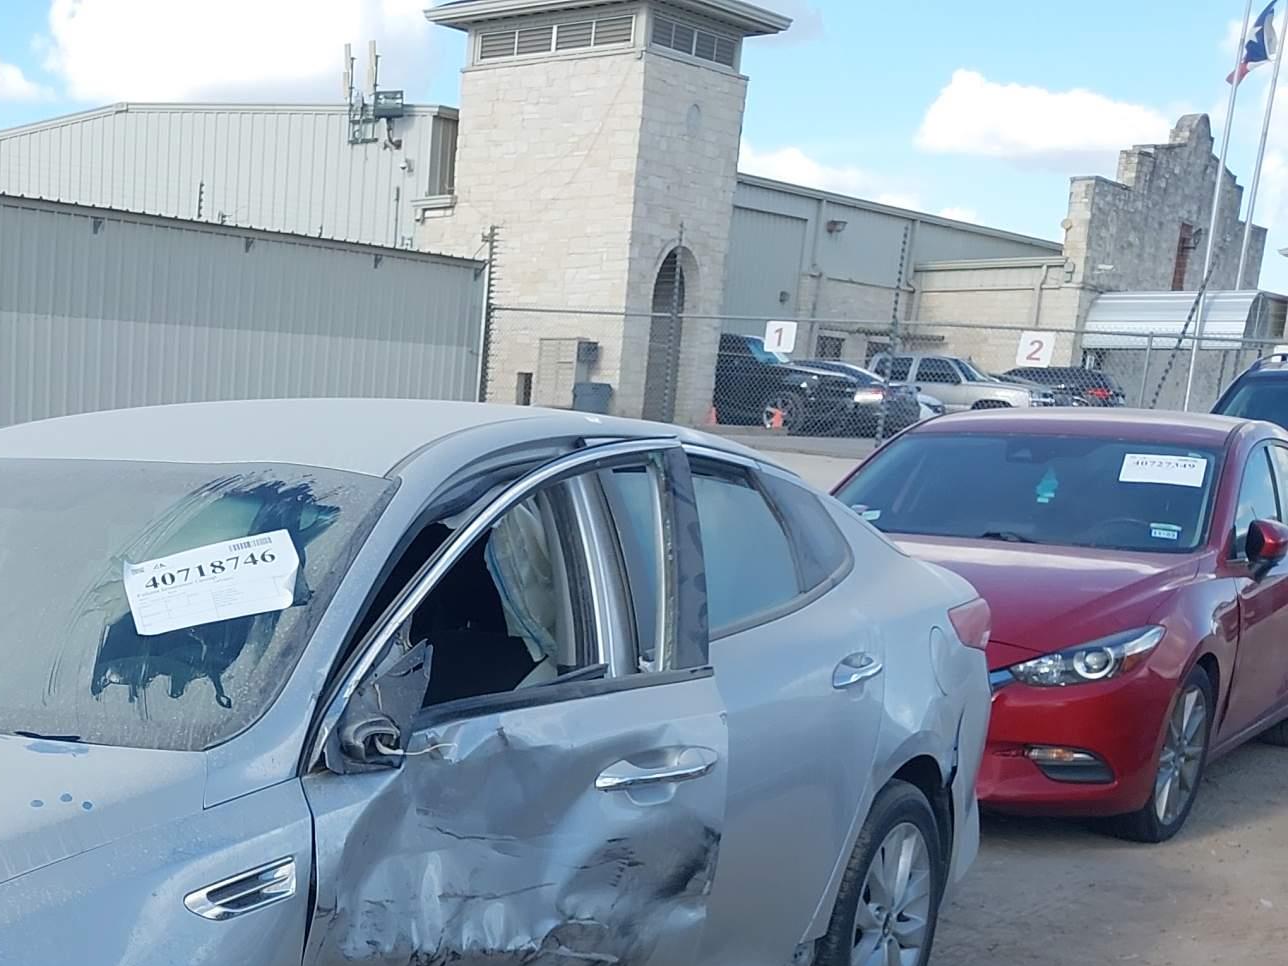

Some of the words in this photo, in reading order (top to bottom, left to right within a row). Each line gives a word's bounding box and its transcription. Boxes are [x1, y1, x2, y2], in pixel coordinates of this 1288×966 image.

[773, 327, 784, 347] 1
[1026, 340, 1045, 361] 2
[144, 549, 276, 589] 40718746
